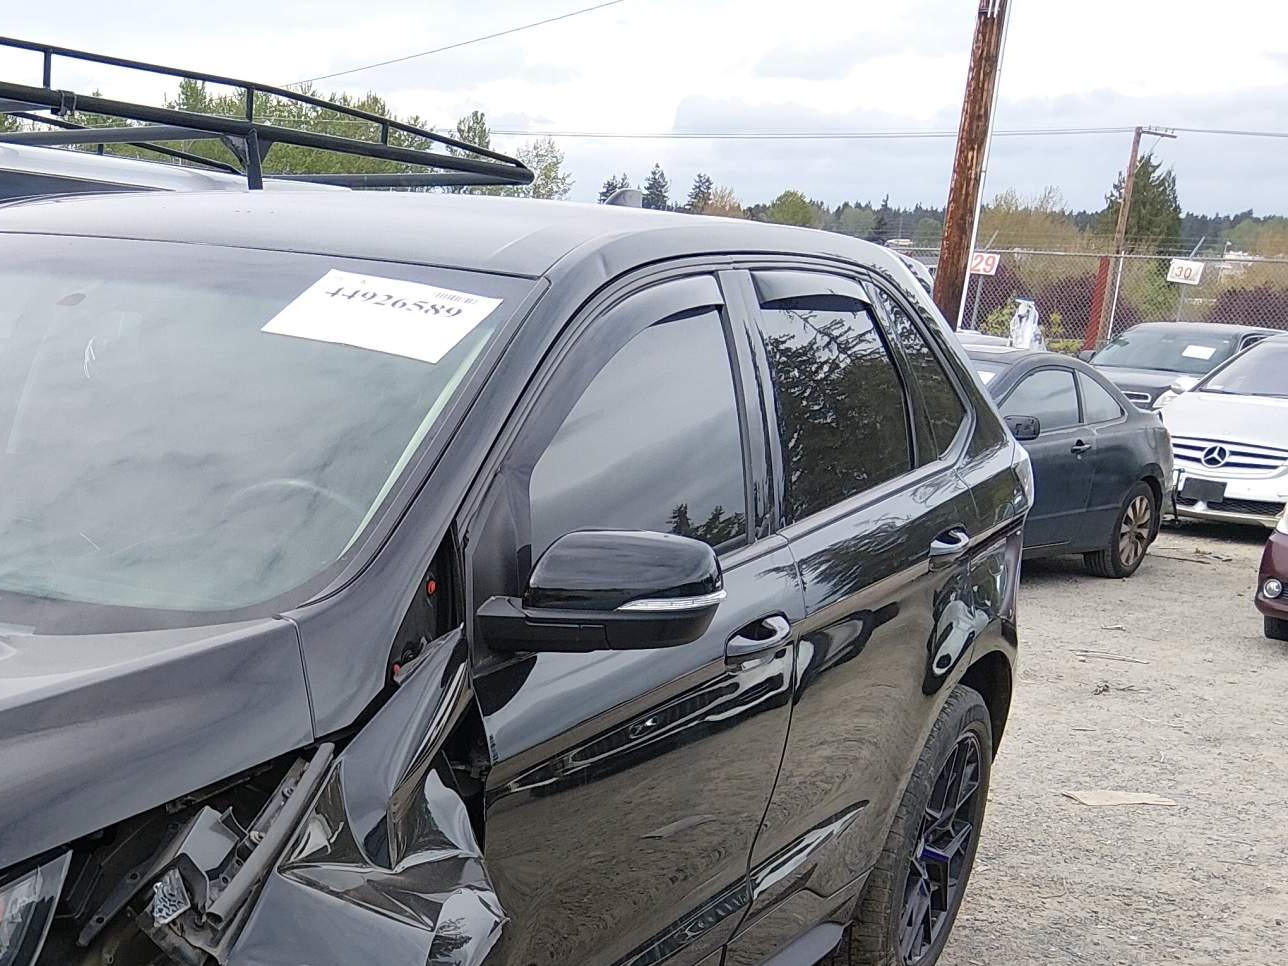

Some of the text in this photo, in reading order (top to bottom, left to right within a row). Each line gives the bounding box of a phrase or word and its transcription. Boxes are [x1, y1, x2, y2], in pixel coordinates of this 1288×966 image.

[970, 254, 996, 273] 29
[1175, 266, 1192, 279] 30
[325, 286, 463, 318] 44926589
